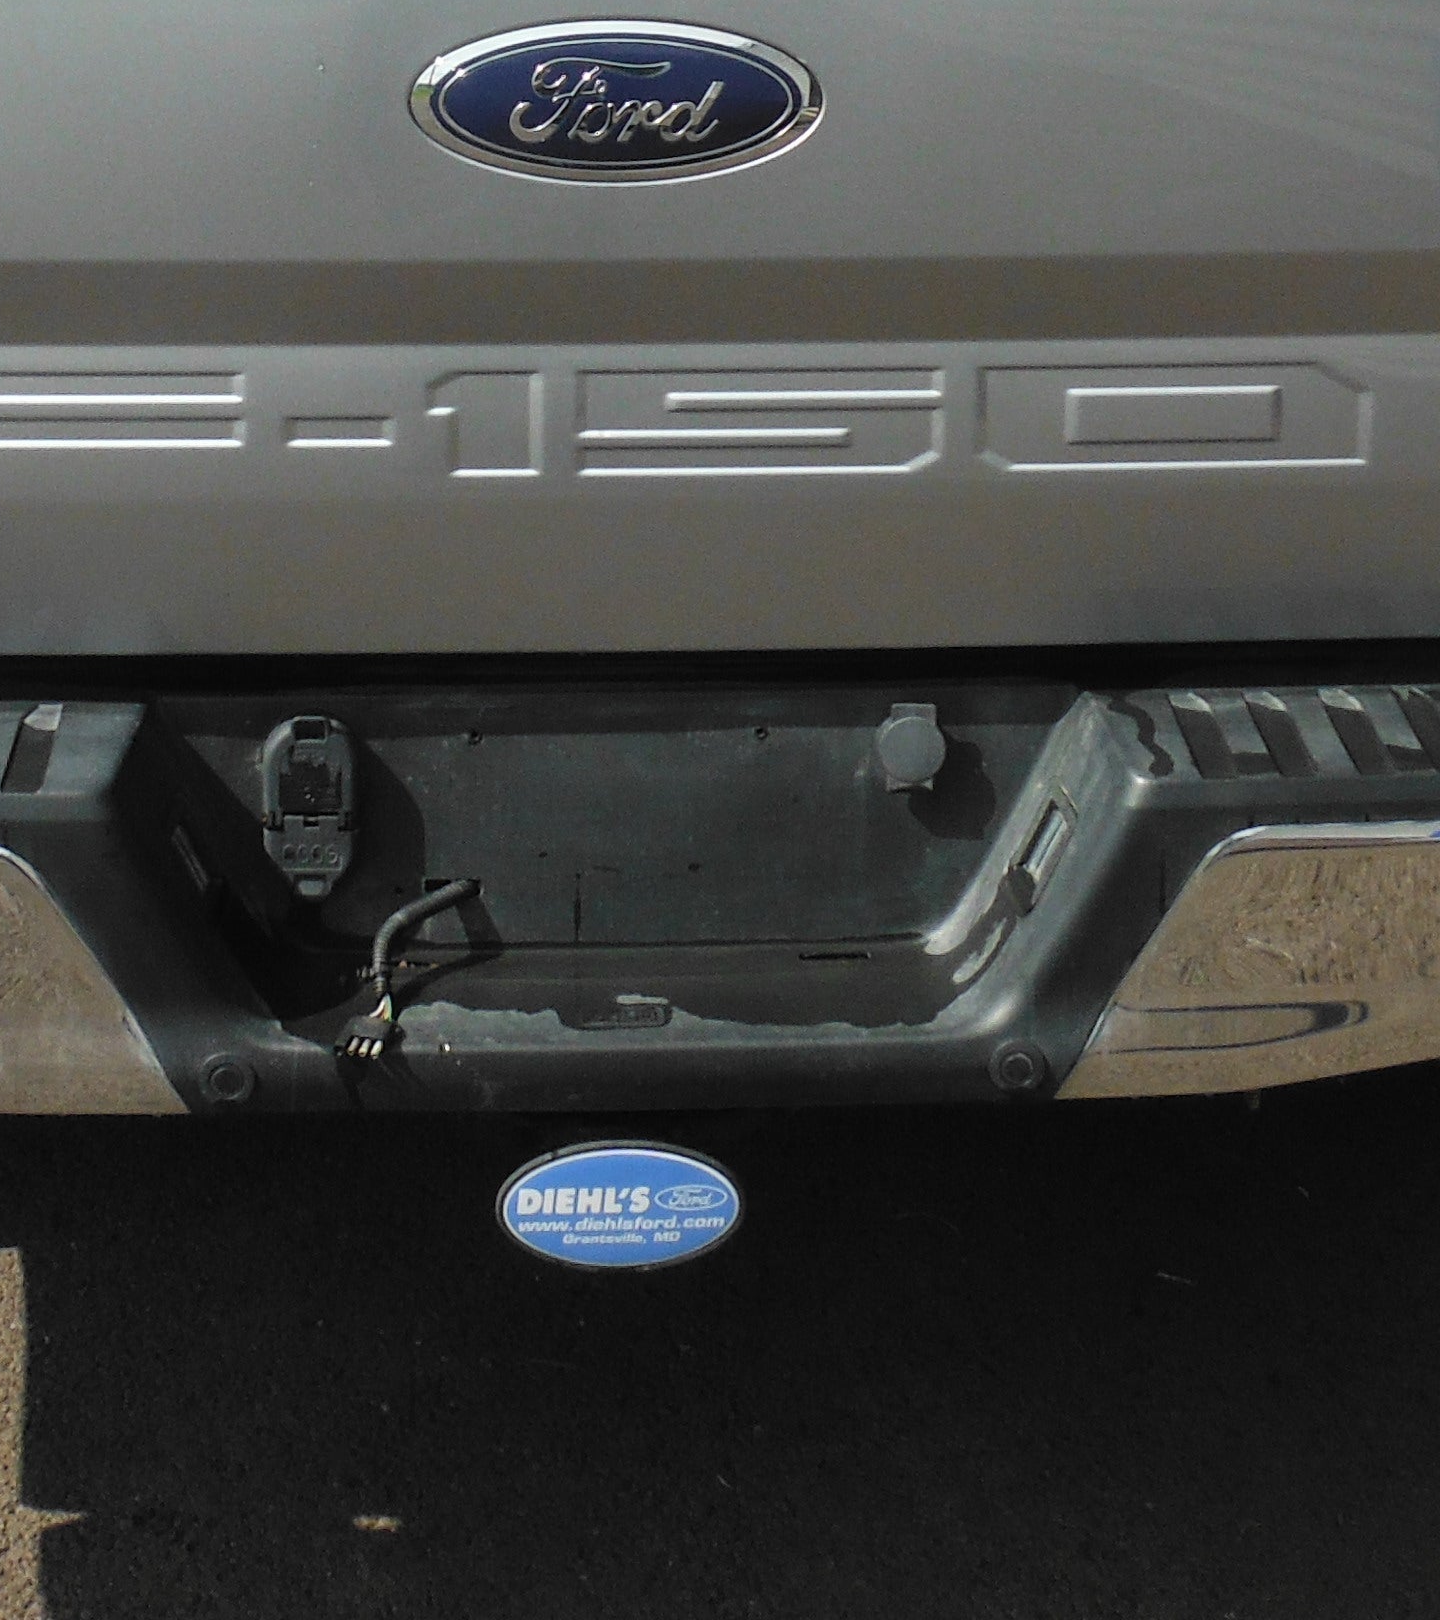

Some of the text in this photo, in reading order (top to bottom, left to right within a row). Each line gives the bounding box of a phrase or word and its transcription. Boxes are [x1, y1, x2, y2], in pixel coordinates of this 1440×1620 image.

[509, 56, 724, 143] Ford
[517, 1186, 651, 1215] DIEHL'S
[518, 1215, 726, 1232] www.diehlsford.com
[653, 1230, 681, 1242] MD
